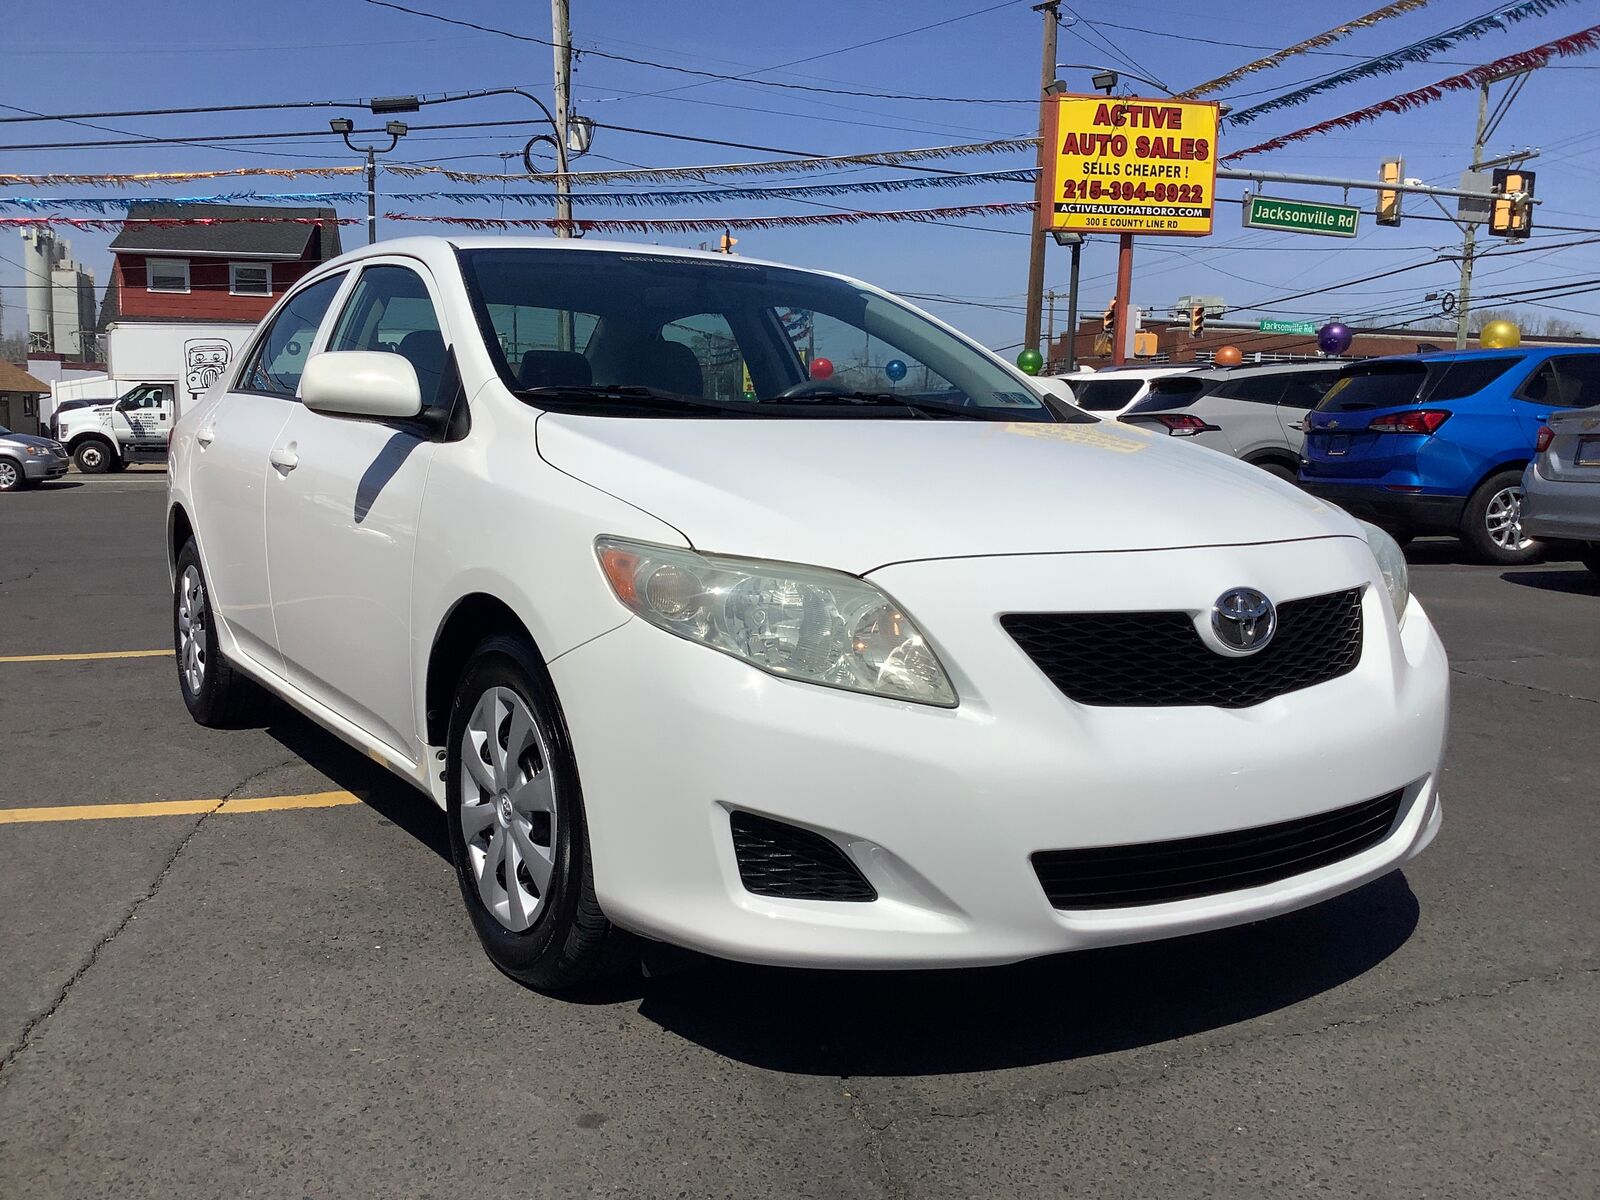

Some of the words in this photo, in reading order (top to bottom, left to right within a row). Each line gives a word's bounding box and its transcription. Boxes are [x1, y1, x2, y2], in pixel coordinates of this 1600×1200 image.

[1093, 104, 1182, 129] ACTIVE
[1062, 133, 1128, 157] AUTO
[1135, 136, 1209, 161] SALES
[1083, 162, 1121, 176] SELLS
[1124, 164, 1181, 178] CHEAPER
[1063, 179, 1203, 203] 215-394-8922
[1060, 204, 1203, 216] ACTIVEAUTOHATBORO.COM
[1255, 205, 1334, 226] Jacksonville
[1338, 214, 1354, 228] Rd
[1086, 218, 1100, 226] 300
[1102, 218, 1107, 226] E
[1110, 218, 1143, 227] COUNTY
[1146, 219, 1165, 228] LINE
[1167, 220, 1178, 228] RD
[1262, 321, 1303, 333] Jacksonville
[1303, 324, 1313, 333] Rd
